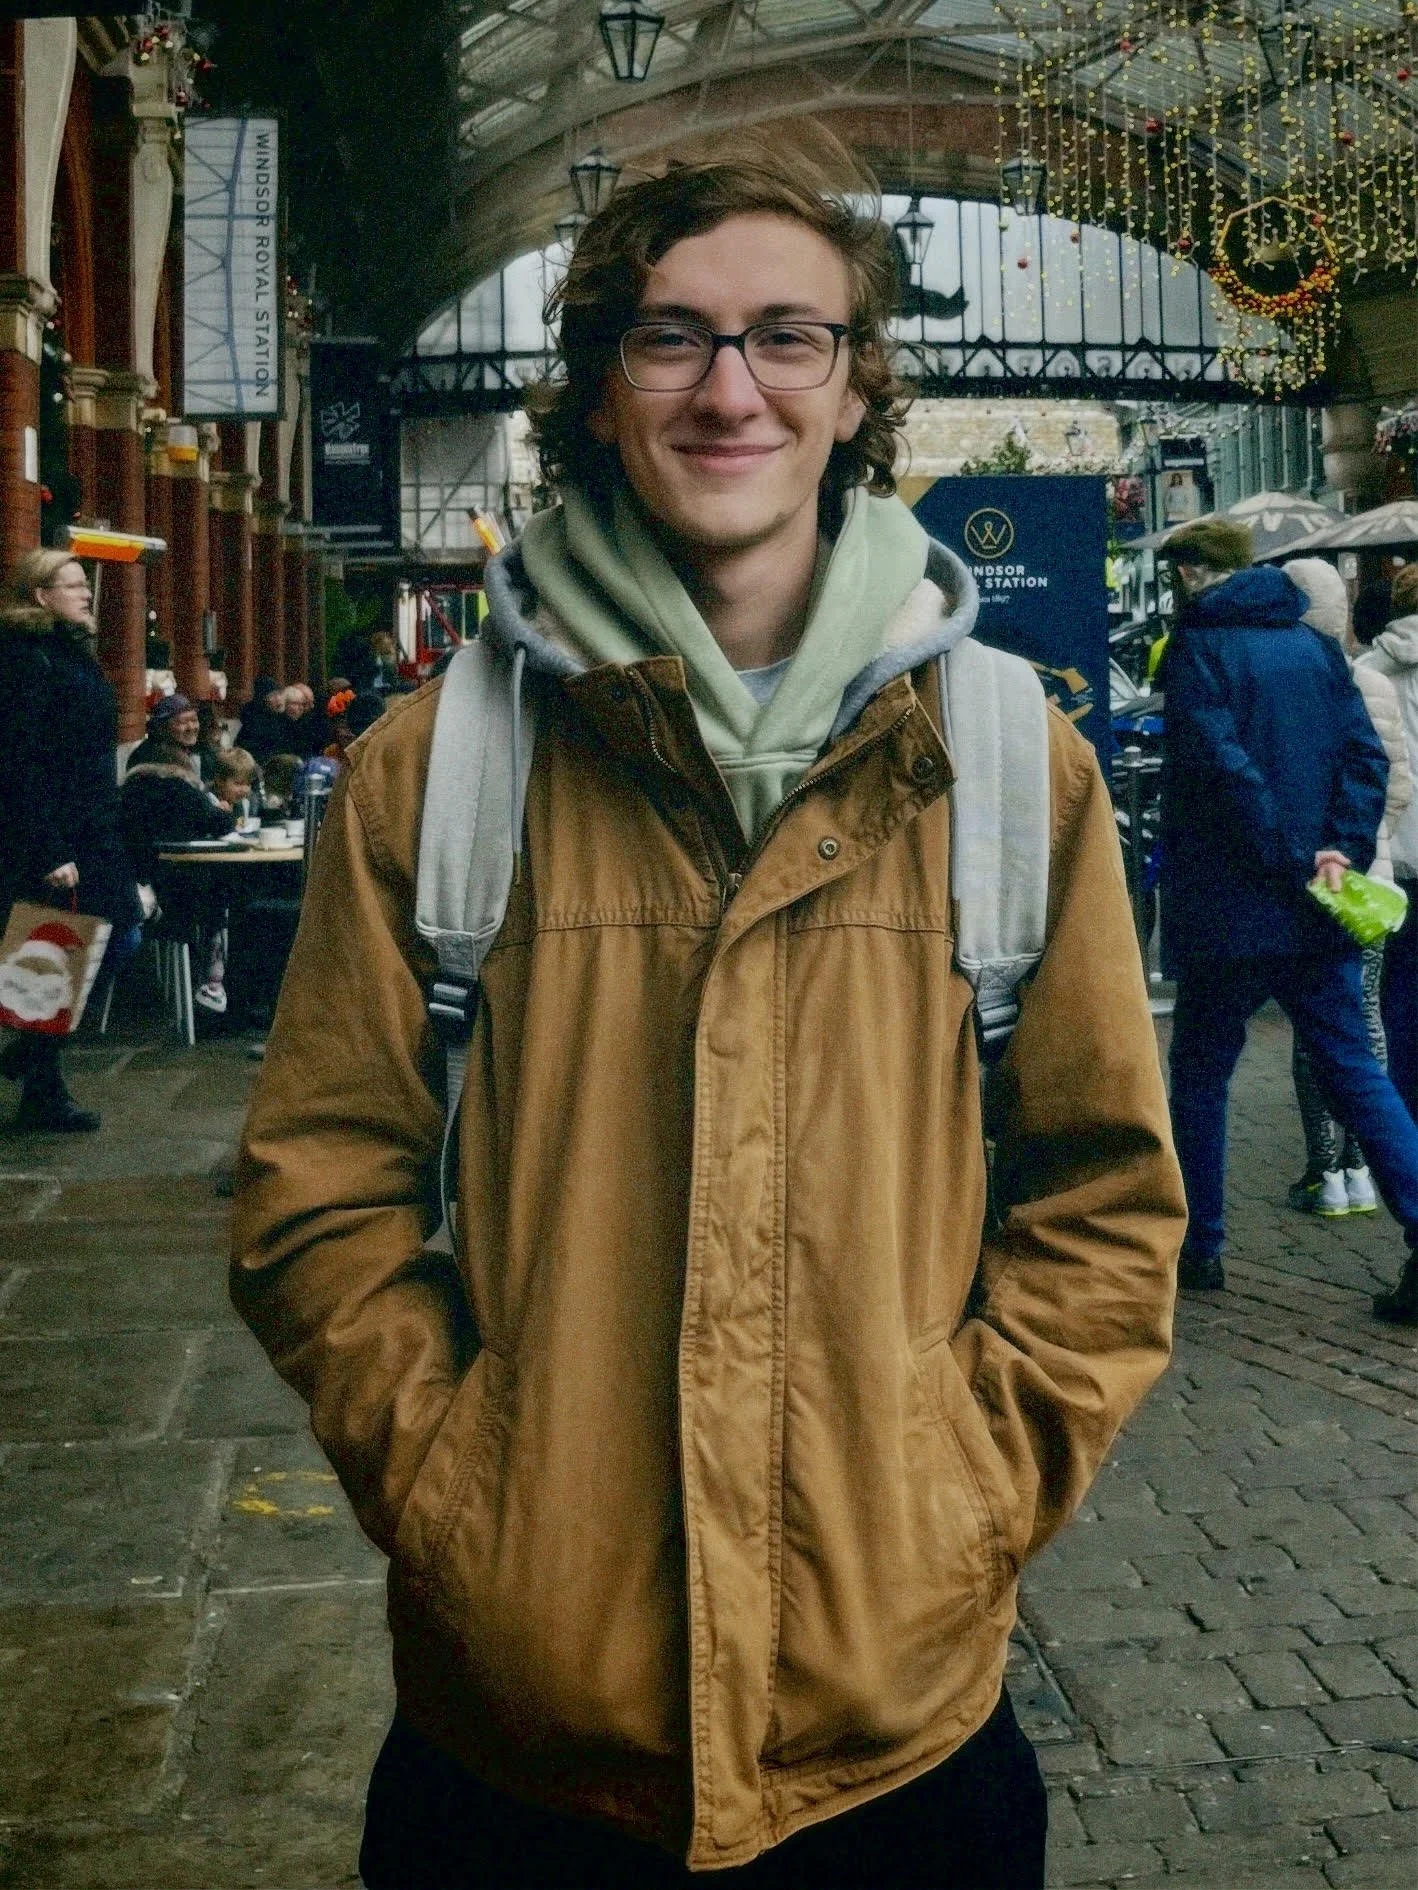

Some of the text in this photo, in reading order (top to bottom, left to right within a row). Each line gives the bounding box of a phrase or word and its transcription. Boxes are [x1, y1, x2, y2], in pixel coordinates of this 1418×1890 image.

[255, 132, 270, 397] WINDSOR ROYAL STATION
[985, 576, 1048, 588] STATION
